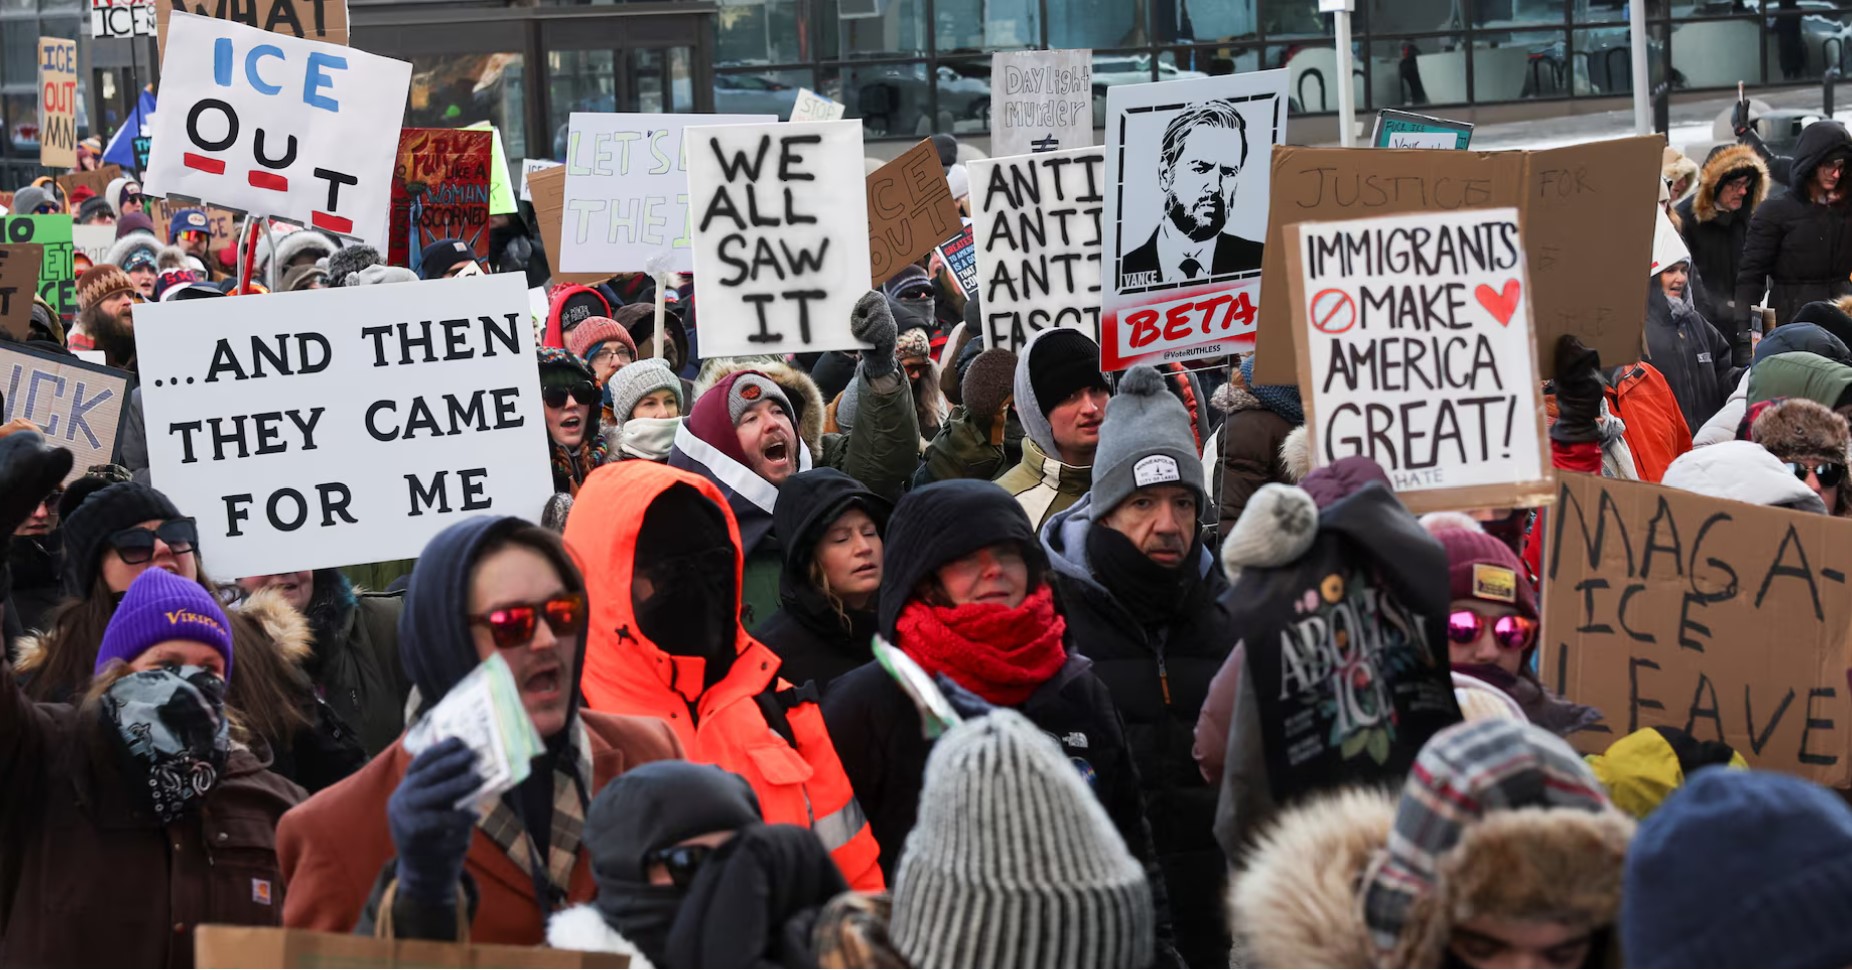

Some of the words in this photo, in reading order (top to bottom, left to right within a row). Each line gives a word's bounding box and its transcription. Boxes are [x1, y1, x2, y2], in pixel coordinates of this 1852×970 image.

[93, 5, 149, 38] ICE
[43, 45, 76, 73] ICE
[214, 38, 348, 112] ICE
[43, 82, 76, 112] OUT
[45, 116, 76, 151] MN
[186, 98, 358, 212] OUT
[568, 129, 671, 176] LET'S
[709, 134, 822, 182] WE
[425, 183, 488, 205] WOMAN
[445, 161, 470, 178] LIKE
[474, 161, 487, 178] A
[871, 148, 943, 221] CE
[984, 155, 1104, 212] ANTI
[1296, 167, 1491, 209] JUSTICE
[1539, 164, 1597, 199] FOR
[421, 205, 489, 227] SCORNED
[568, 196, 667, 246] THE
[700, 184, 818, 232] ALL
[870, 186, 951, 279] OUT
[986, 207, 1103, 253] ANTI
[717, 233, 830, 287] SAW
[1307, 222, 1519, 280] IMMIGRANTS
[1124, 270, 1158, 288] VANCE
[742, 289, 828, 345] IT
[1125, 292, 1258, 349] BETA
[1359, 282, 1473, 332] MAKE
[361, 313, 521, 367] THEN
[1163, 344, 1221, 360] @VoteRUTHLESS
[1323, 333, 1503, 393] AMERICA
[169, 408, 326, 464] THEY
[365, 387, 525, 441] CAME
[1325, 394, 1518, 471] GREAT!
[222, 481, 359, 538] FOR
[403, 467, 492, 517] ME
[1394, 469, 1443, 489] HATE
[1574, 577, 1713, 653] ICE
[1559, 643, 1839, 766] LEAVE
